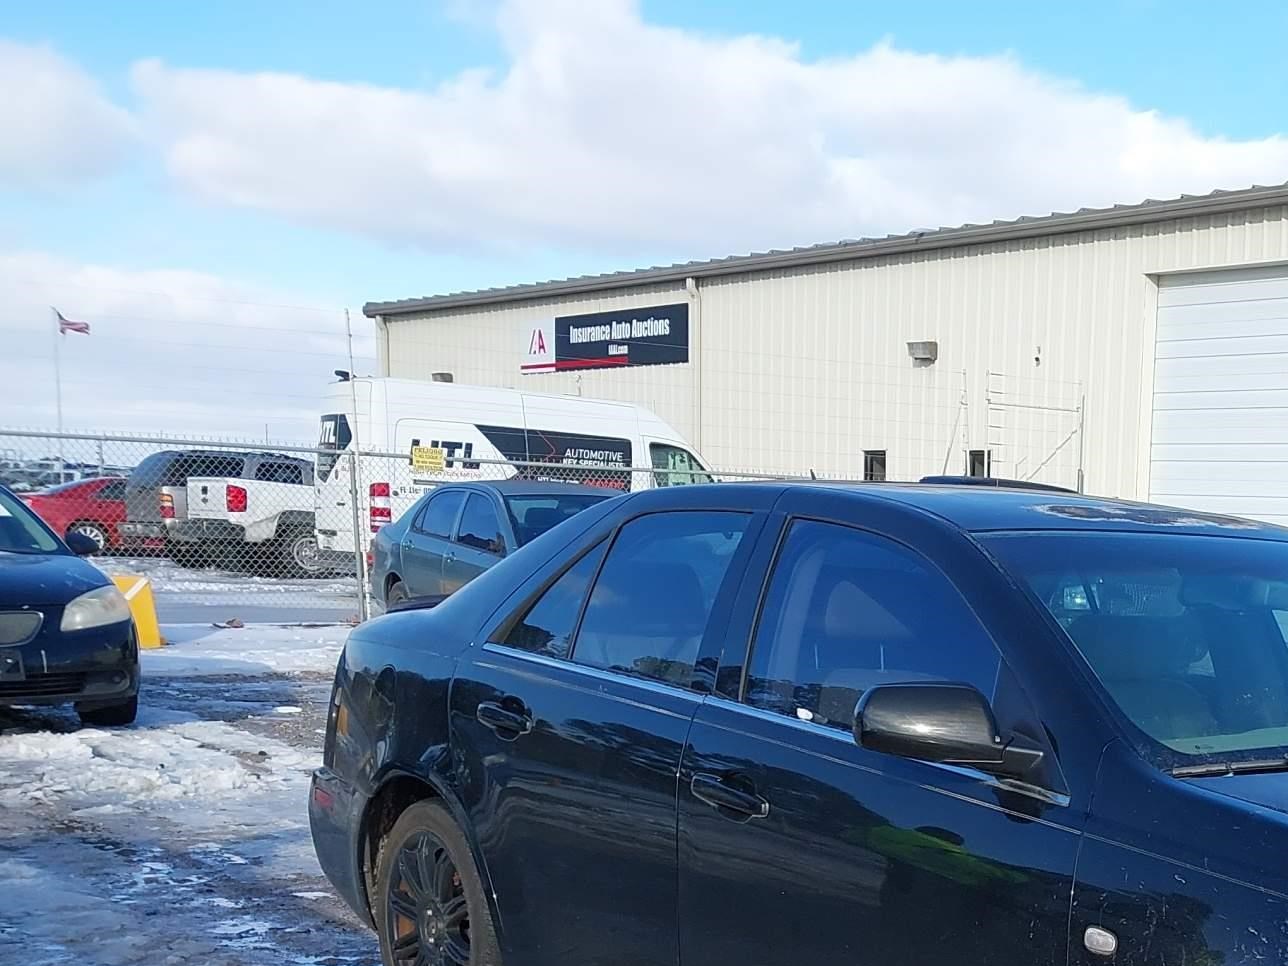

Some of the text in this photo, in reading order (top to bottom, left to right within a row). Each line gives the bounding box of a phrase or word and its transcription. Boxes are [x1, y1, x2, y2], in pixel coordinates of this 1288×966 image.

[570, 317, 670, 344] Insurance Auto Auctions
[565, 448, 624, 461] AUTOMOTIVE
